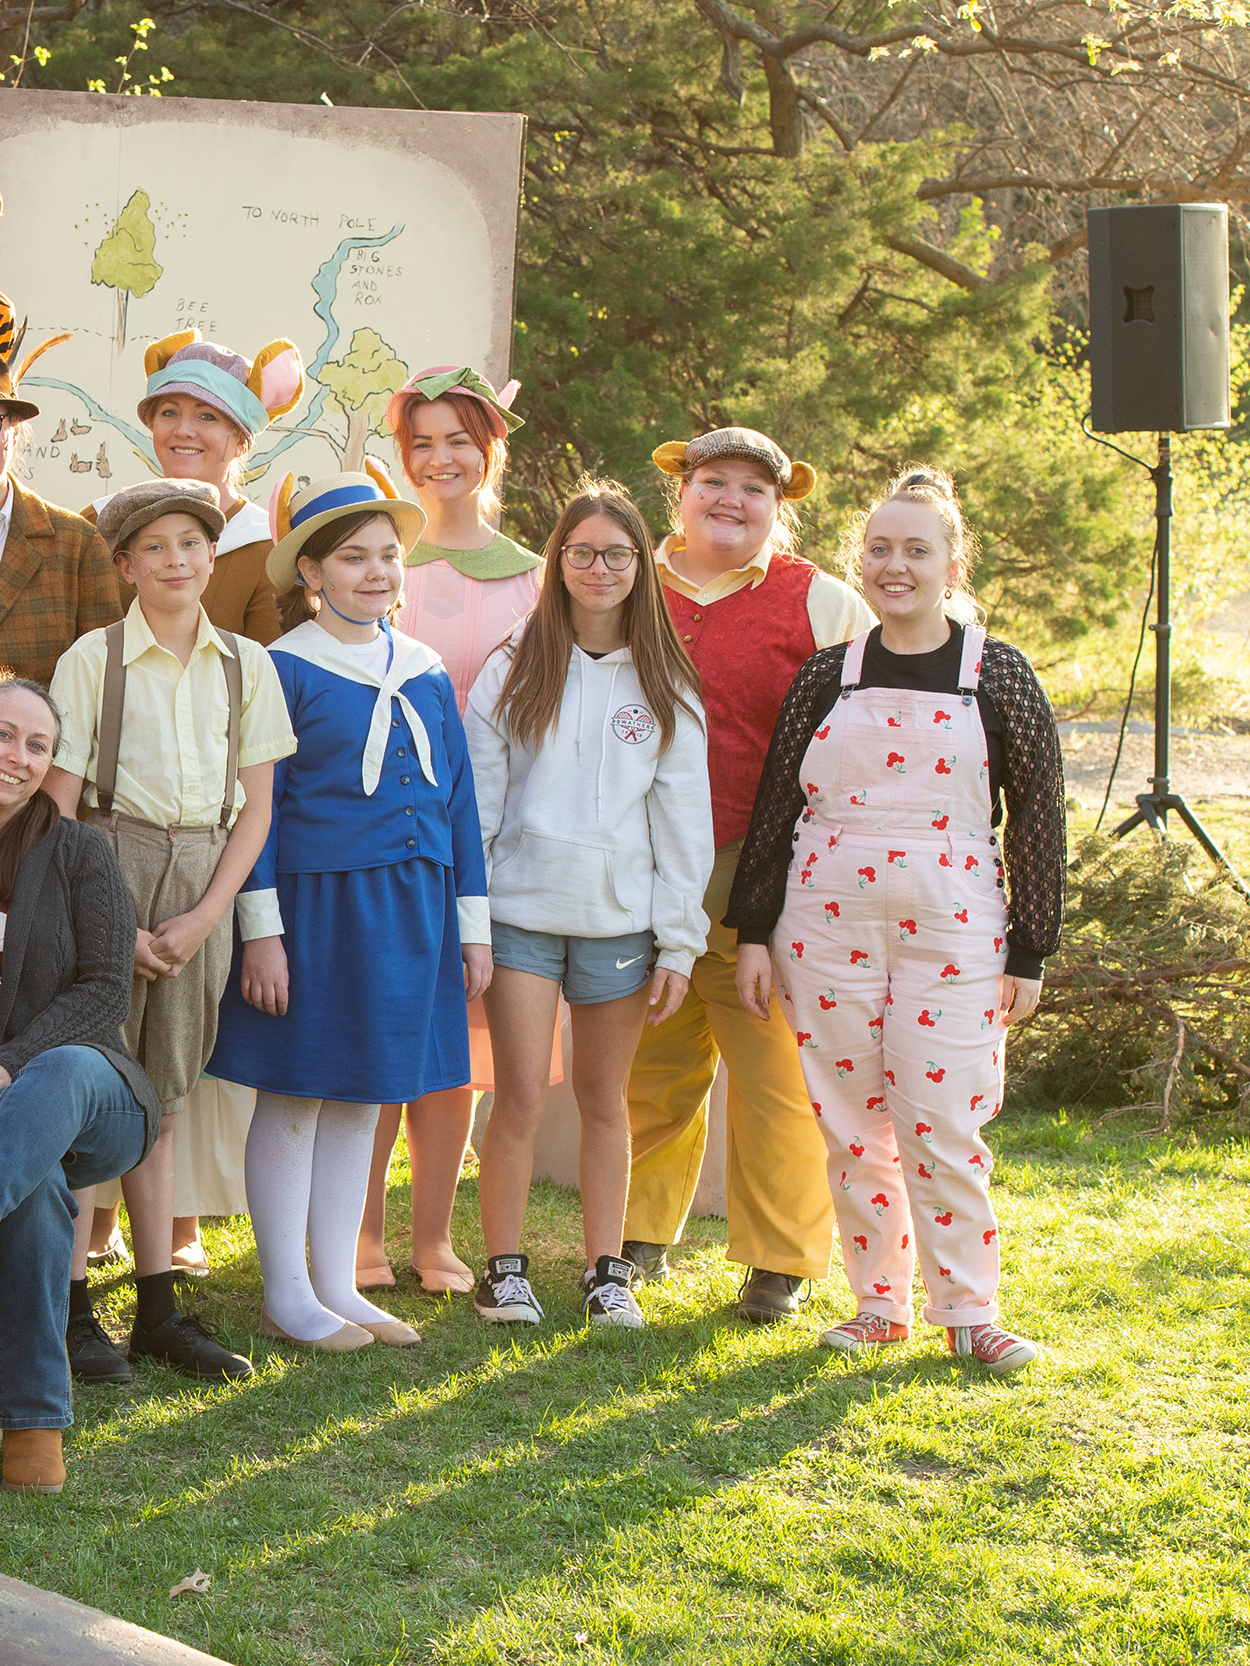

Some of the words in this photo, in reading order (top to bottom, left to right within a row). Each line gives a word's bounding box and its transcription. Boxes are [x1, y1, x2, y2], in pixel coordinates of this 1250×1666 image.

[242, 206, 262, 219] TO
[271, 209, 319, 227] NORTH
[339, 214, 376, 231] POLE
[357, 250, 380, 262] BIG
[350, 264, 403, 277] STONES
[351, 280, 378, 291] AND
[176, 298, 208, 312] BEE
[355, 292, 382, 306] ROX
[176, 317, 217, 332] TREE
[22, 443, 60, 458] AND
[616, 719, 651, 729] SWATHER
